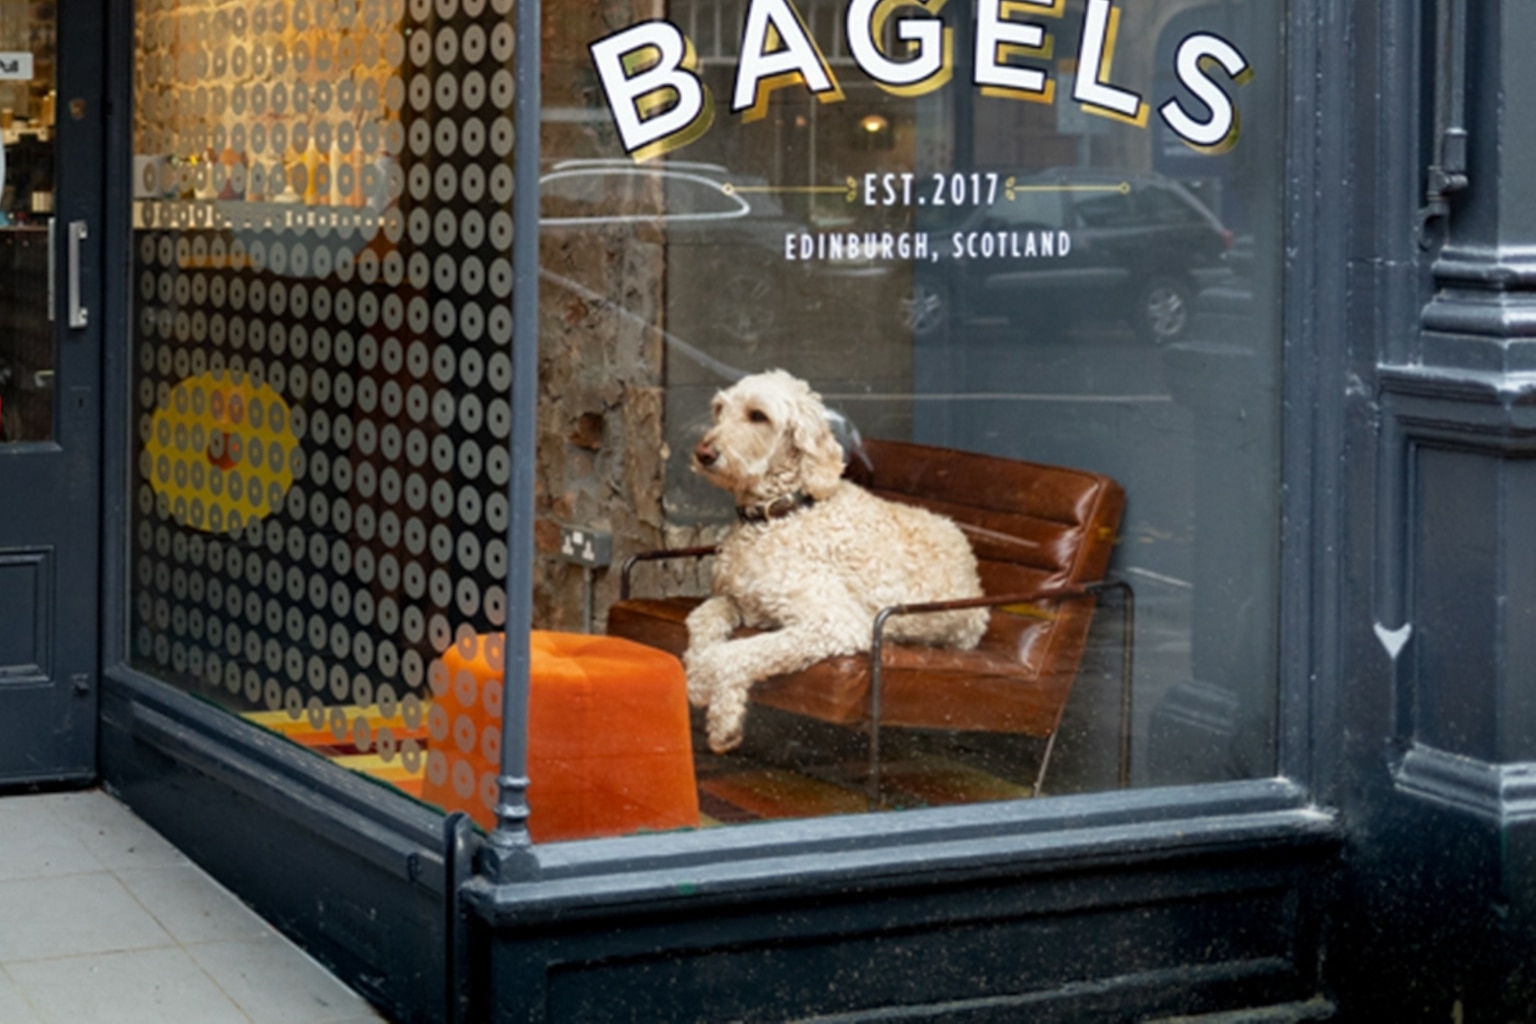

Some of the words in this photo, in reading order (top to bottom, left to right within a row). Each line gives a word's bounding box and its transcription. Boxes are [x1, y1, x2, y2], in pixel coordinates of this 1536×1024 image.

[864, 172, 999, 207] EST.2017
[784, 231, 940, 263] EDINBURGH,
[952, 230, 1071, 259] SCOTLAND
